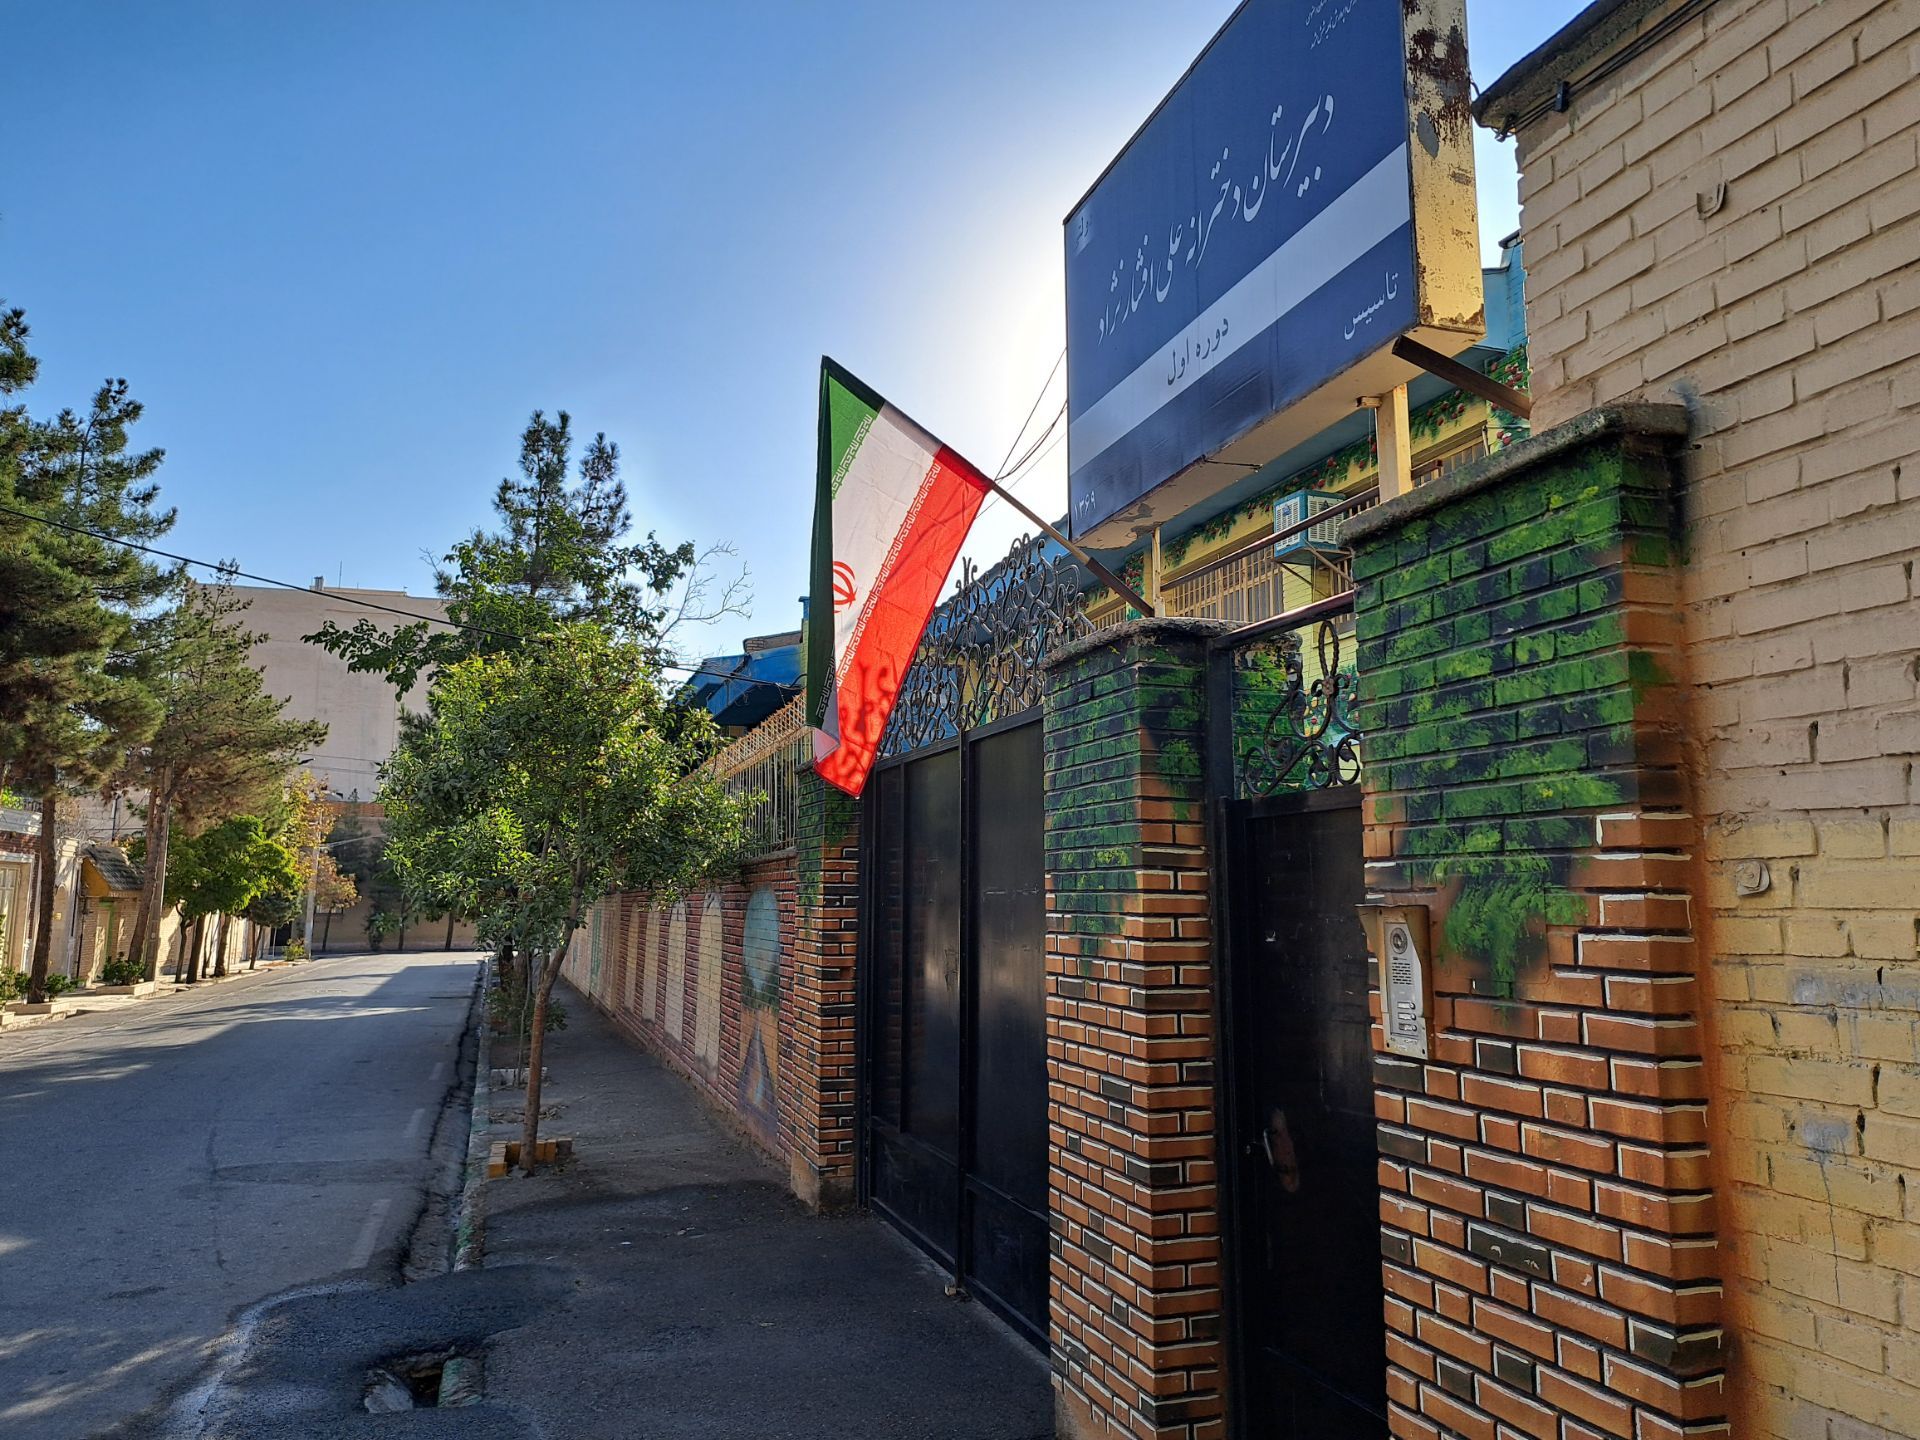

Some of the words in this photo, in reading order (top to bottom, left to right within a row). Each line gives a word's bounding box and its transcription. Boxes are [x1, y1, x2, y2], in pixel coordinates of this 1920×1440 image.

[1243, 94, 1334, 222] دبیرستان
[1185, 147, 1241, 271] دخترانه
[1156, 222, 1183, 303] علی
[1196, 318, 1229, 360] دوره
[1344, 272, 1399, 340] تاسیس
[1167, 336, 1189, 386] اول
